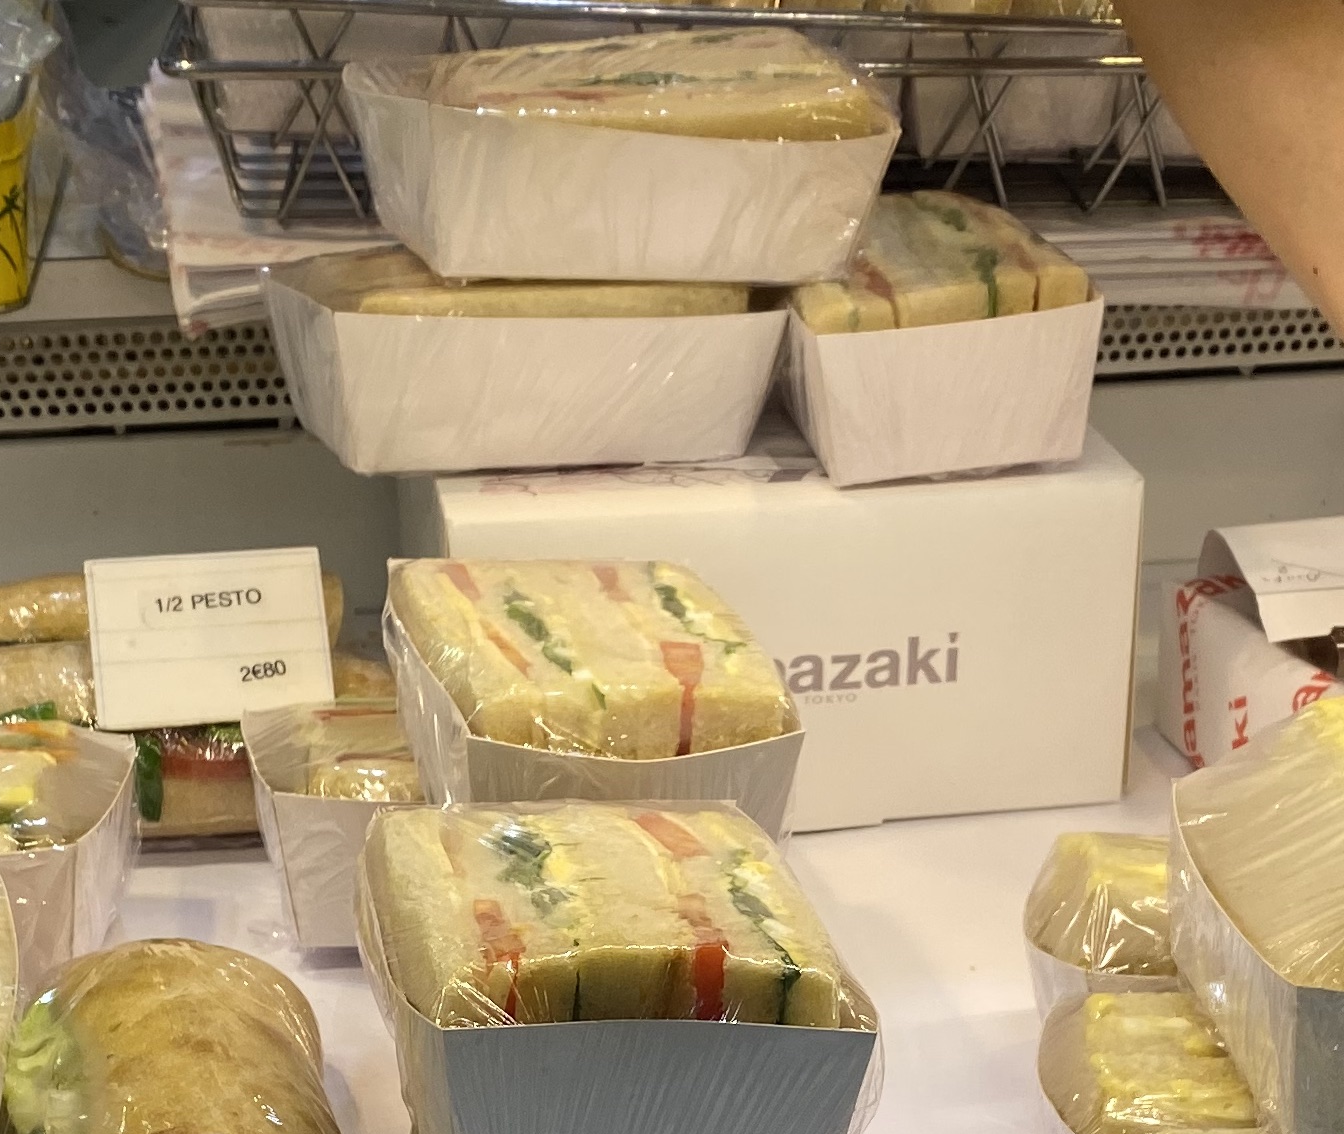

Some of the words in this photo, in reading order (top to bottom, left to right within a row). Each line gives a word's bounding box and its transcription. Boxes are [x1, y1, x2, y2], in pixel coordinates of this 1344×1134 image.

[156, 595, 184, 613] 1/2
[190, 587, 262, 611] PESTO
[240, 659, 287, 683] 2€80
[773, 632, 959, 694] azaki
